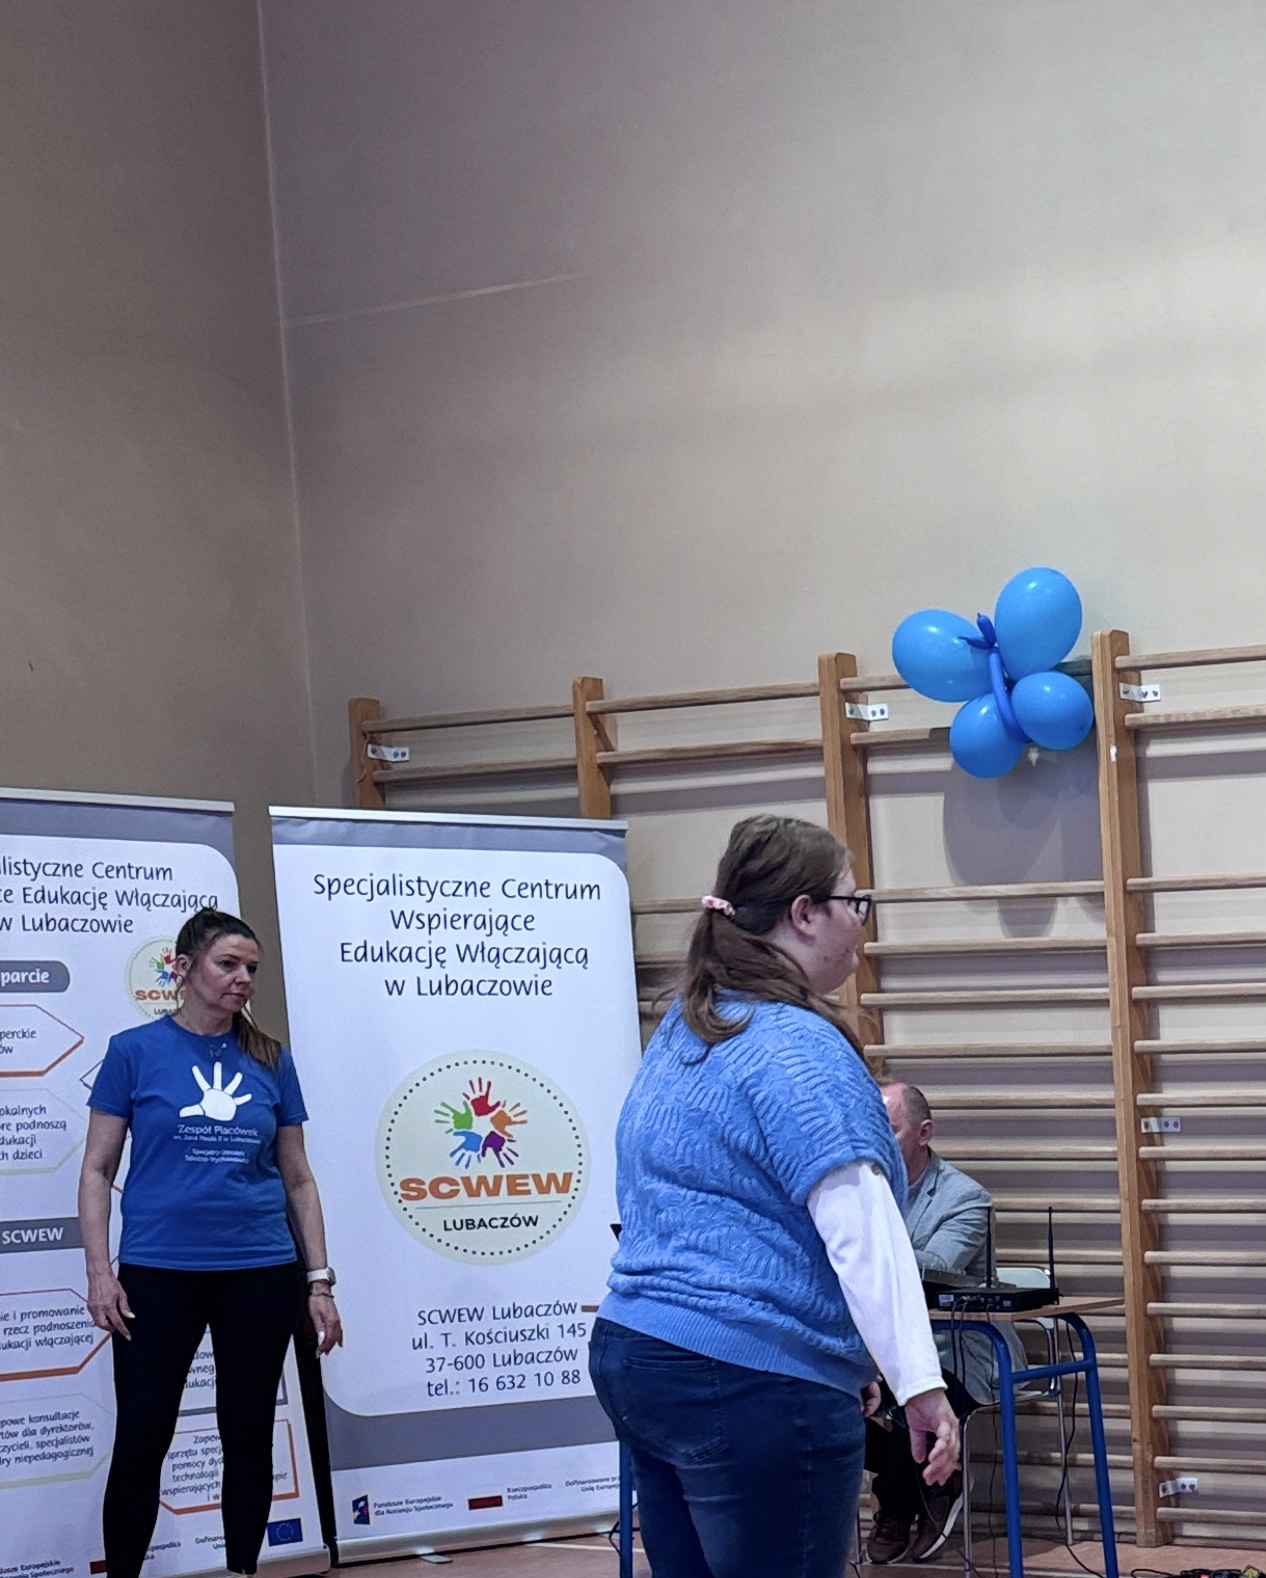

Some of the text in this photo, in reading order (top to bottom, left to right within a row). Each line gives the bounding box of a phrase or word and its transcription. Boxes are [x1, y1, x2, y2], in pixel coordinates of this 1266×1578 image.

[0, 855, 173, 881] listyczne Centrum
[22, 884, 108, 911] Edukację
[313, 873, 602, 903] Specjalistyczne Centrum
[0, 912, 134, 934] w Lubaczowie
[390, 907, 536, 937] Wspierające
[340, 940, 589, 970] Edukację Włączającą
[0, 968, 50, 987] parcie
[384, 973, 553, 997] w Lubaczowie
[135, 989, 188, 1001] SCW
[0, 1028, 37, 1040] perckie
[0, 1104, 47, 1118] okalnych
[16, 1119, 67, 1133] podnoszą
[0, 1134, 37, 1148] dukacji
[12, 1148, 43, 1160] dzieci
[399, 1171, 574, 1202] SCWEW
[442, 1213, 539, 1232] LUBACZÓW
[2, 1227, 64, 1245] SCWEW
[20, 1304, 86, 1322] promowanie
[417, 1300, 578, 1326] SCWEW Lubaczów
[3, 1324, 30, 1336] rzecz
[411, 1321, 588, 1350] ul. T. Kościuszki 145
[0, 1332, 95, 1351] ukacji włączającej
[425, 1345, 579, 1374] 37-600 Lubaczów
[427, 1368, 582, 1397] tel.: 16 632 10 88
[0, 1409, 81, 1429] powe konsultacje
[22, 1426, 37, 1437] dla
[0, 1440, 33, 1454] zycieli,
[35, 1434, 91, 1450] specjalistów
[200, 1445, 222, 1457] specj
[14, 1445, 94, 1464] niepedagogicznej
[172, 1460, 206, 1473] pomocy
